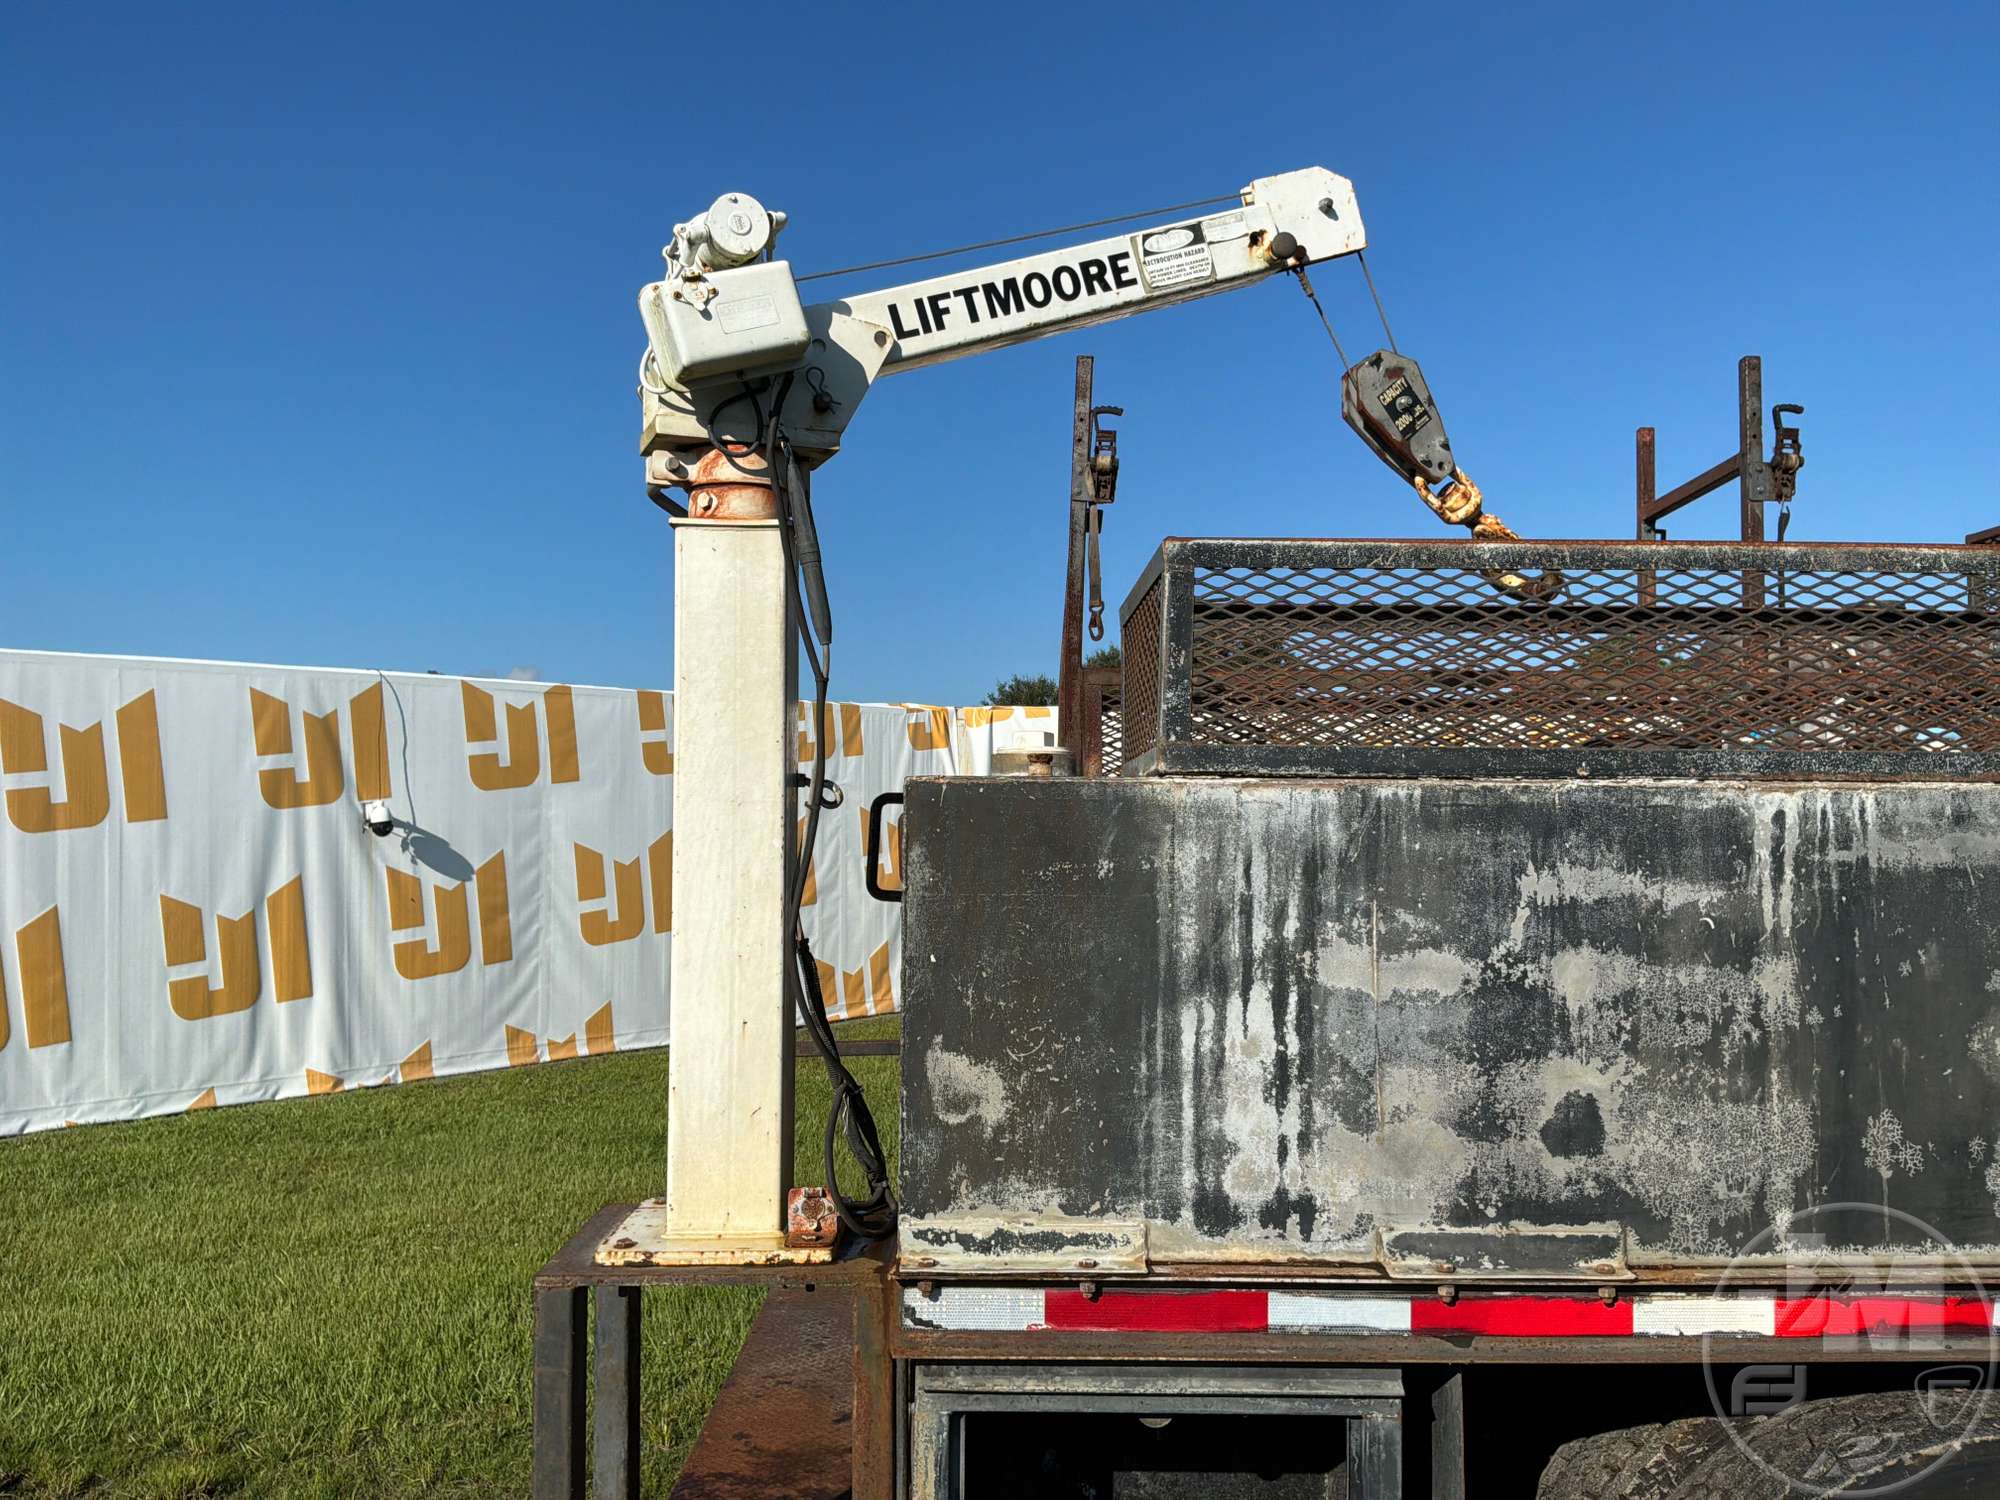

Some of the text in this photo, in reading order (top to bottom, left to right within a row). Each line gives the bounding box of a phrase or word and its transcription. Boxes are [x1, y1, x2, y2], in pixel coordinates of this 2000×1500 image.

[1146, 247, 1205, 266] LECTROCUTION HAZARD
[888, 251, 1137, 340] LIFTMOORE
[1379, 376, 1408, 406] CAPACITY
